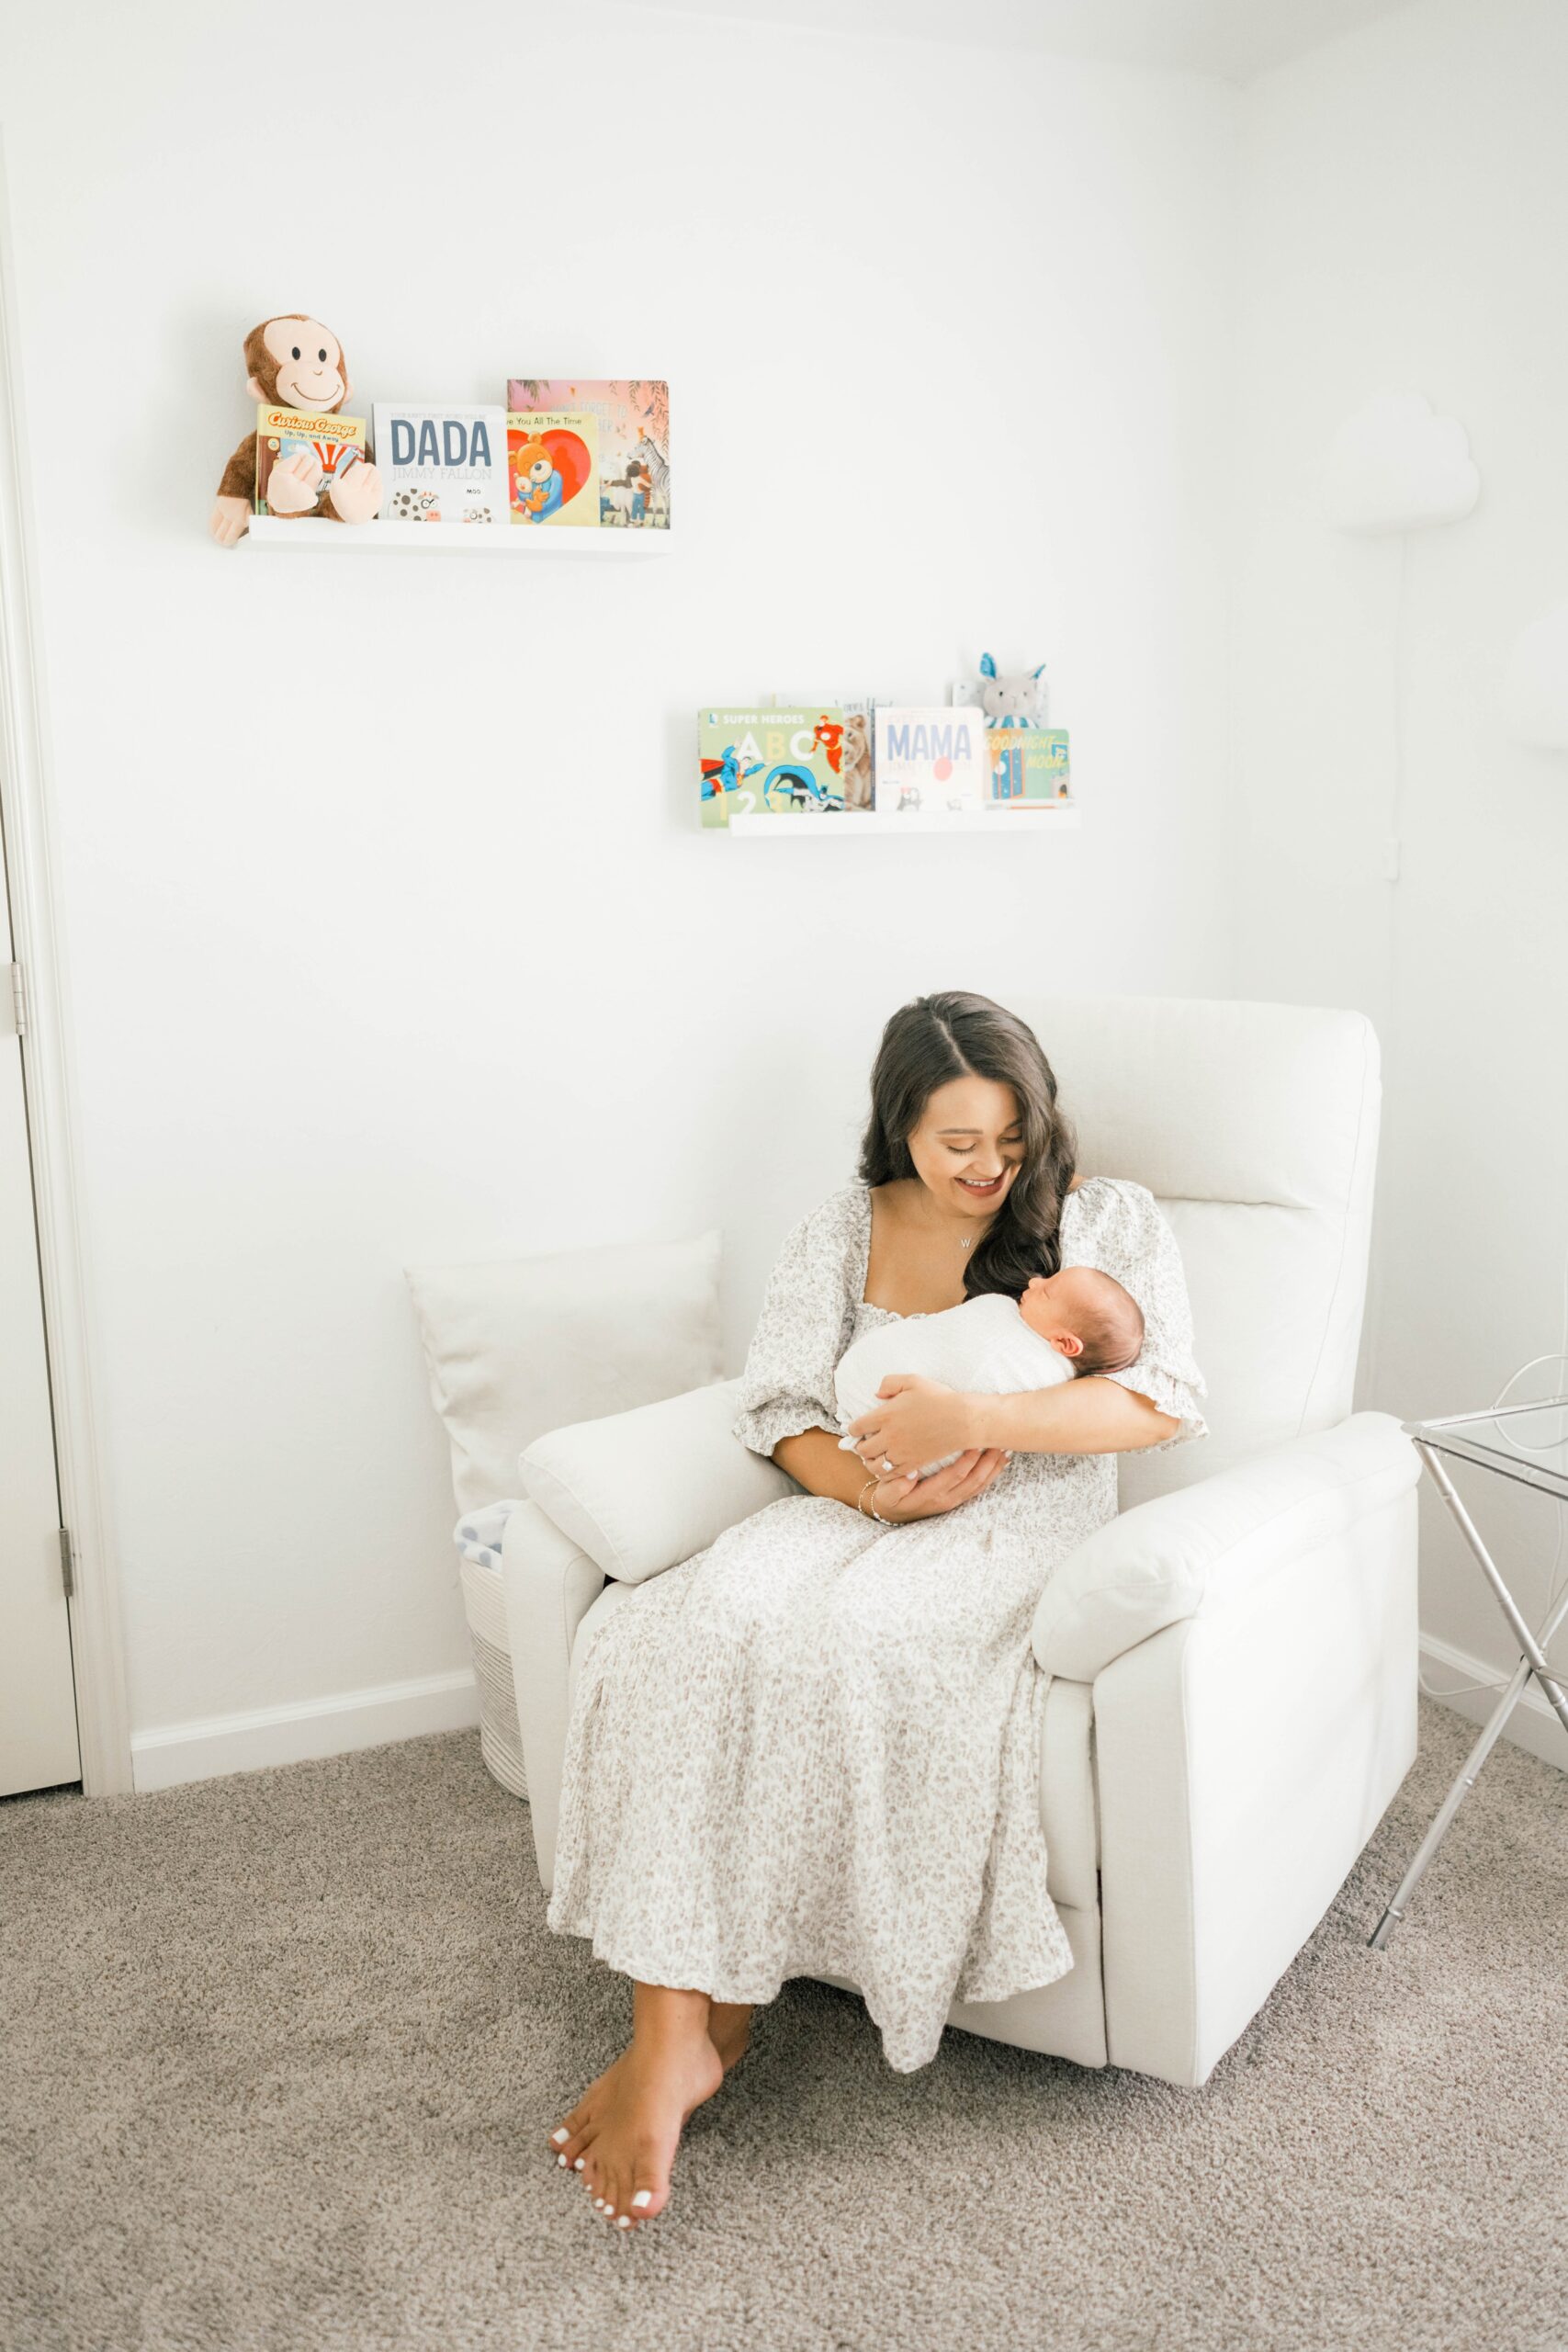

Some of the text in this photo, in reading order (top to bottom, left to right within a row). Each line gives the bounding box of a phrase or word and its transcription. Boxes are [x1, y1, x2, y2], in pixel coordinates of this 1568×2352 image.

[267, 412, 357, 438] Curious George
[516, 417, 531, 425] You
[534, 417, 544, 425] All
[322, 434, 339, 442] Away
[390, 419, 492, 467] DADA
[392, 468, 492, 481] JIMMY FALLON
[723, 714, 805, 724] SUPER HEROES
[887, 724, 972, 761] MAMA
[983, 734, 1055, 751] GOODNIGHT
[961, 1236, 971, 1248] W
